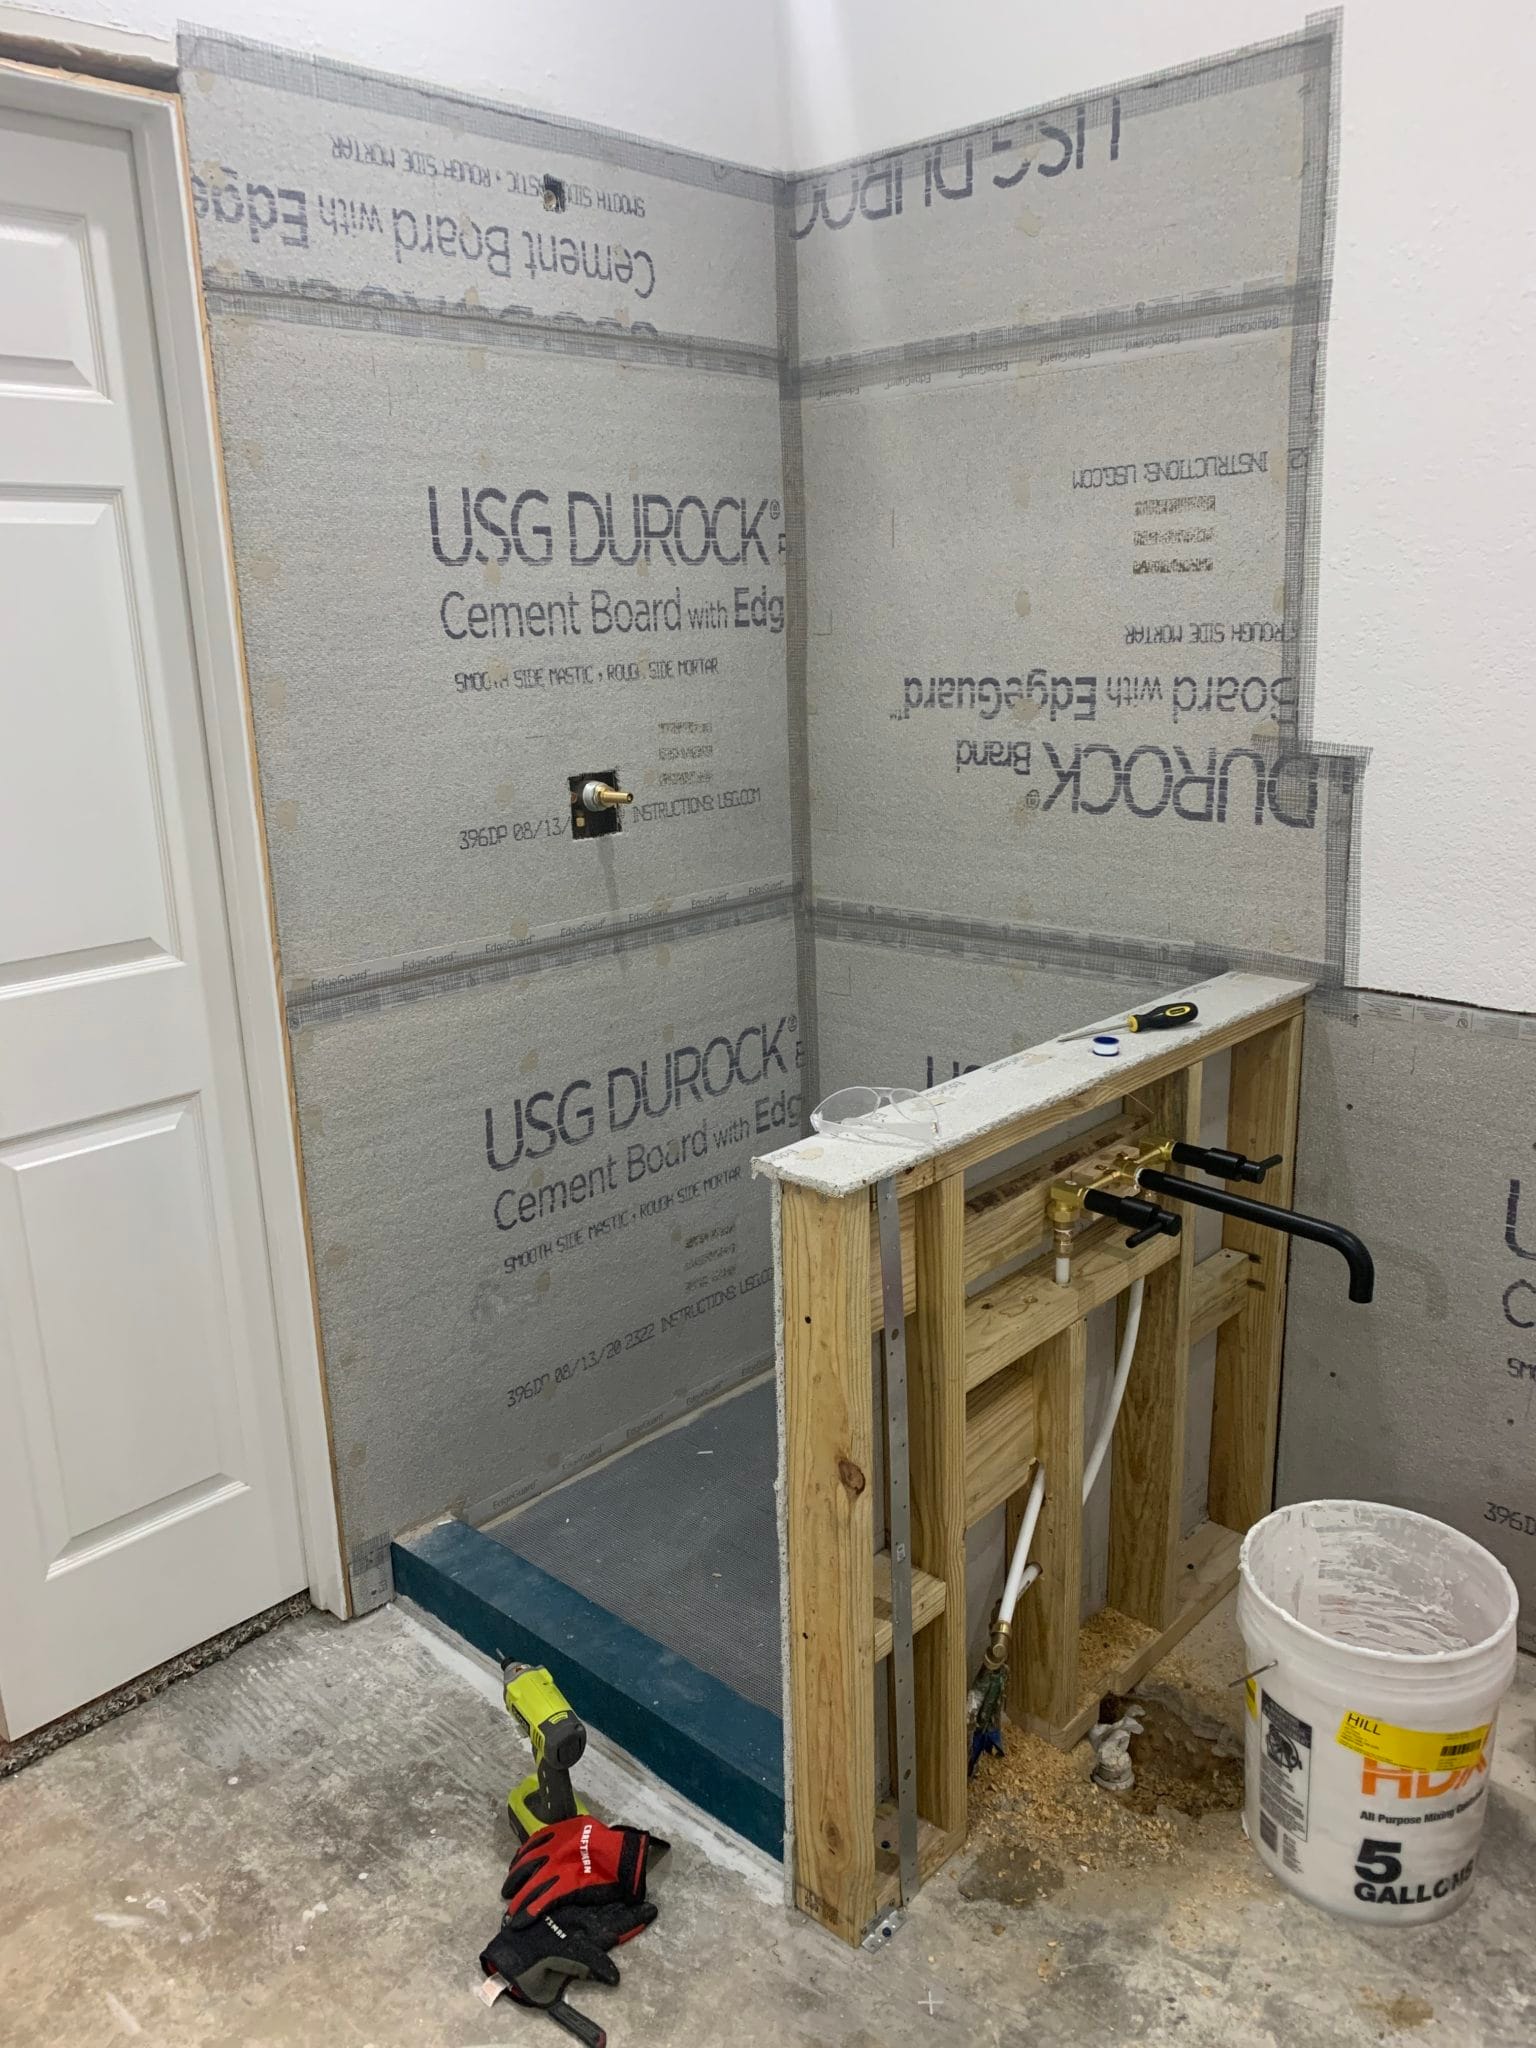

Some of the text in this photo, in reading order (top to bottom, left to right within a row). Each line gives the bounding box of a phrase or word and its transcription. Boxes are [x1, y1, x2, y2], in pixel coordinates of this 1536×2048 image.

[331, 136, 395, 168] MORTAR
[403, 148, 437, 177] SIDE
[444, 158, 491, 187] ROUGH
[319, 194, 383, 236] with
[597, 195, 646, 218] SMOOTH
[392, 206, 511, 278] Board
[522, 230, 656, 299] Cement
[428, 486, 553, 566] USG
[440, 590, 581, 640] Cement
[591, 587, 682, 634] Board
[688, 602, 728, 629] with
[1124, 624, 1183, 646] MORTAR
[1190, 622, 1226, 645] SIDE
[513, 667, 545, 689] SIDE
[549, 665, 594, 687] MASTIC
[649, 660, 674, 680] SIDE
[677, 657, 720, 676] MORTAR
[1107, 674, 1162, 708] with
[956, 740, 1031, 776] Brand
[459, 825, 508, 851] 396DP
[484, 1080, 595, 1172] USG
[494, 1151, 619, 1231] Cement
[627, 1115, 709, 1185] Board
[713, 1117, 751, 1151] with
[503, 1165, 742, 1275] SMOOTH SIDE MASTIC ROUGH SIDE MORTAR
[1347, 1712, 1382, 1737] HILL
[1360, 1810, 1375, 1823] All
[1378, 1813, 1423, 1827] Purpose
[1354, 1838, 1402, 1884] 5
